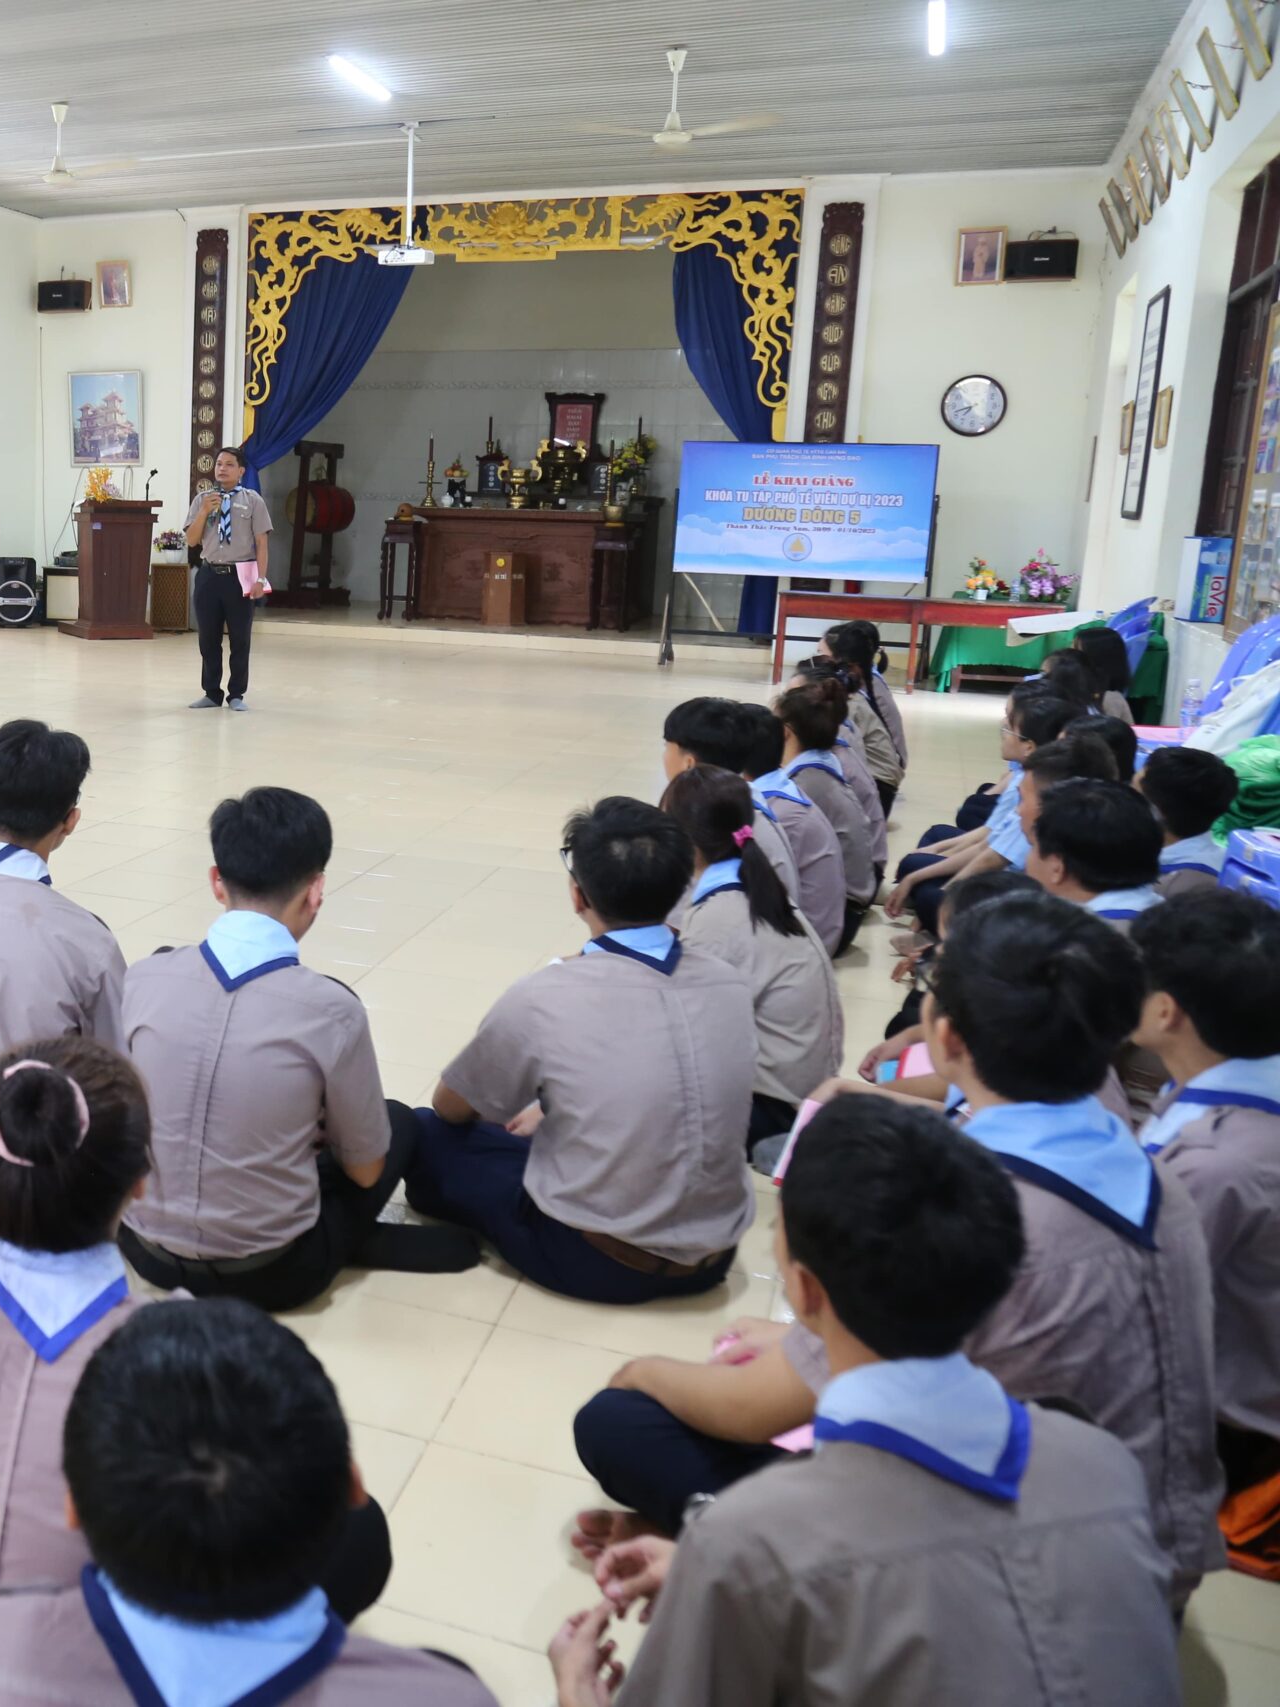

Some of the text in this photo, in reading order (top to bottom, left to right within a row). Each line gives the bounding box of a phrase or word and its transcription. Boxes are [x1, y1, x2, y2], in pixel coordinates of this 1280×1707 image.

[753, 471, 855, 487] LỄ KHAI GIẢNG
[735, 490, 750, 502] TU
[774, 487, 797, 504] PHỔ
[799, 488, 814, 504] TẾ
[814, 490, 839, 506] VIÊN
[841, 493, 858, 508] DỰ
[861, 494, 871, 508] BỊ
[874, 495, 904, 507] 2023
[849, 510, 861, 525] 5
